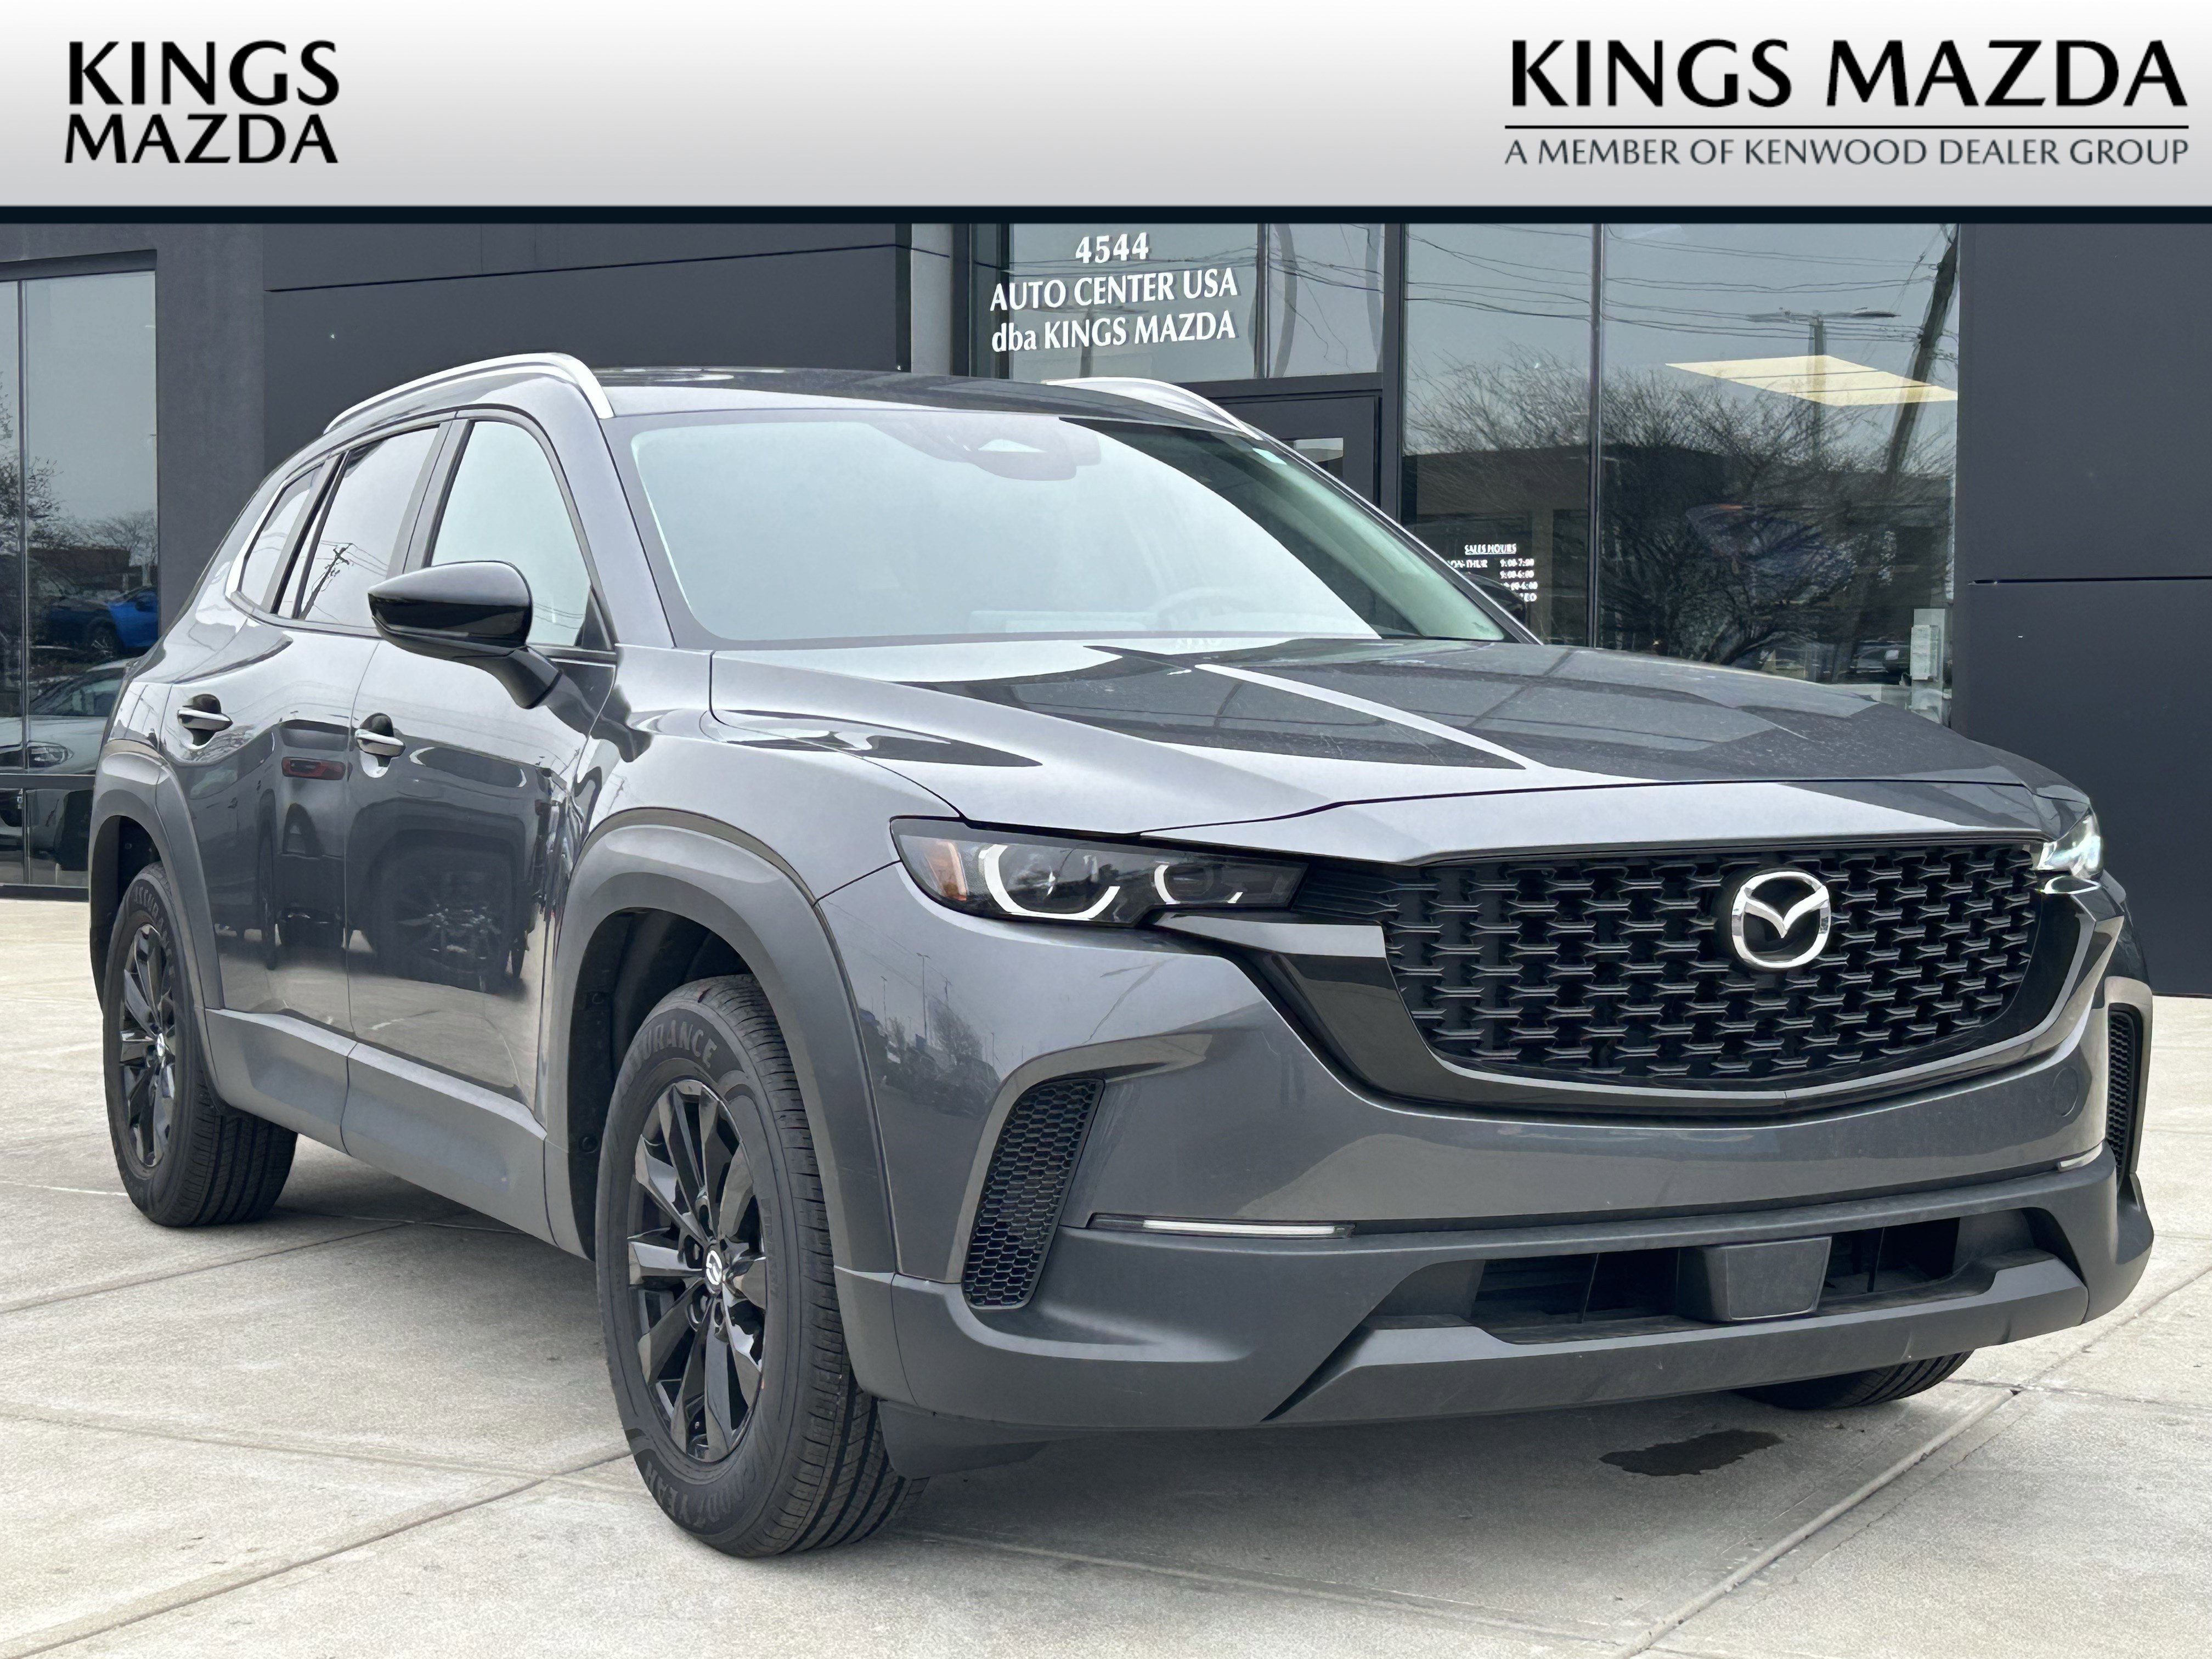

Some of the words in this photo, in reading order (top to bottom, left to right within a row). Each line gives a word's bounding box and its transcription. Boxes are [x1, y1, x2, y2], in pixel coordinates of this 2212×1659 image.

[1075, 232, 1149, 264] 4544
[990, 279, 1066, 311] AUTO
[1074, 272, 1175, 306] CENTER
[1183, 267, 1238, 299] USA
[992, 323, 1037, 352] dba
[1045, 317, 1126, 349] KINGS
[1135, 310, 1235, 344] MAZDA
[1487, 543, 1516, 554] HOURS
